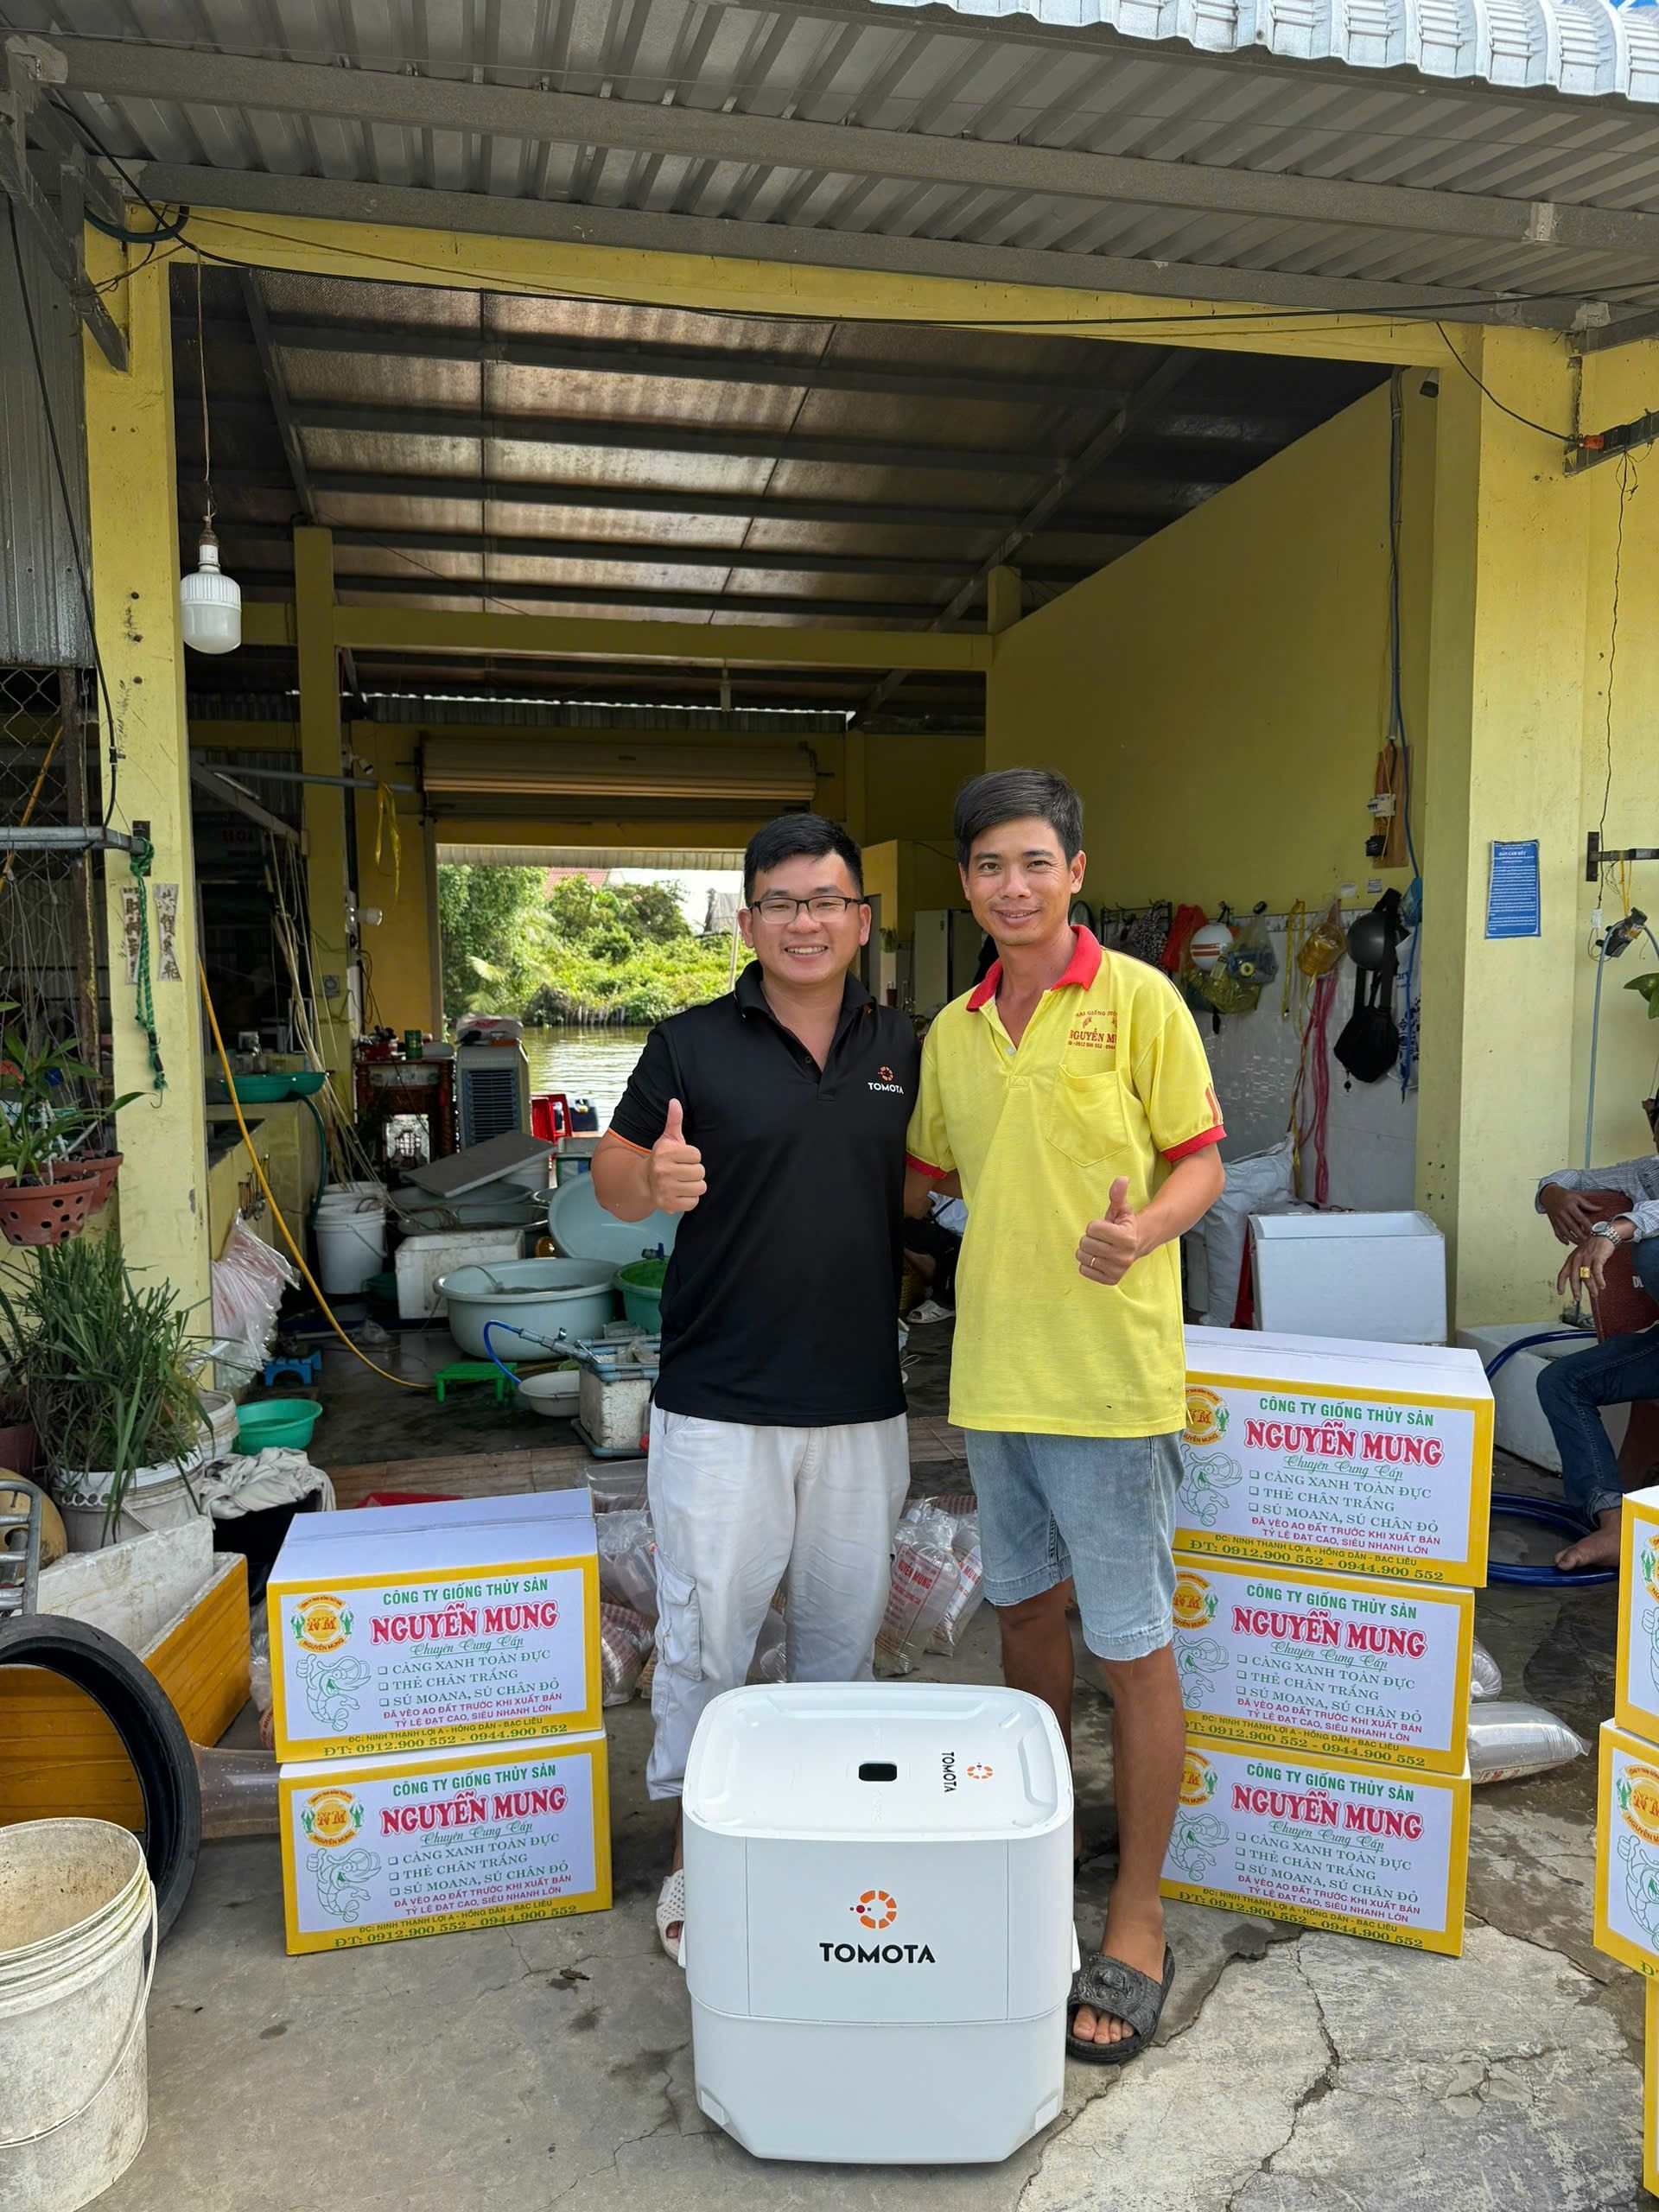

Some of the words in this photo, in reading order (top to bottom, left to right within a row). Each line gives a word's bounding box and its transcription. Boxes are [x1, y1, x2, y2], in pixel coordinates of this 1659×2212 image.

[868, 1082, 905, 1095] TOMOTA
[1259, 1395, 1295, 1413] CÔNG
[1300, 1402, 1316, 1414] TY
[1320, 1402, 1362, 1419] GIỐNG
[1366, 1406, 1402, 1423] THỦY
[1407, 1409, 1433, 1426] SẢN
[1244, 1417, 1357, 1459] NGUYỄN
[1360, 1430, 1442, 1466] MUNG
[1264, 1470, 1305, 1484] CÀNG
[1307, 1476, 1348, 1490] XANH
[1353, 1478, 1395, 1495] TOÀN
[1398, 1486, 1431, 1500] ĐỰC
[1189, 1539, 1217, 1552] ĐT:
[1222, 1543, 1290, 1561] 0912.900
[1295, 1554, 1324, 1566] 552
[1338, 1559, 1409, 1576] 0944.900
[1414, 1568, 1443, 1580] 552
[383, 1589, 418, 1605] CÔNG
[423, 1589, 438, 1601] TY
[442, 1582, 481, 1599] GIỐNG
[486, 1579, 518, 1596] THỦY
[523, 1576, 547, 1592] SẢN
[1246, 1583, 1281, 1600] CÔNG
[1286, 1590, 1302, 1603] TY
[1306, 1591, 1346, 1610] GIỐNG
[1351, 1598, 1386, 1614] THỦY
[1390, 1602, 1416, 1618] SẢN
[369, 1602, 477, 1644] NGUYỄN
[484, 1601, 558, 1634] MUNG
[1232, 1605, 1342, 1647] NGUYỄN
[1345, 1621, 1425, 1659] MUNG
[392, 1661, 431, 1674] CÀNG
[435, 1657, 474, 1670] XANH
[478, 1649, 518, 1666] TOÀN
[520, 1649, 550, 1662] ĐỰC
[392, 1675, 422, 1689] THẺ
[425, 1673, 466, 1687] CHÂN
[469, 1667, 518, 1682] TRẮNG
[1251, 1655, 1291, 1670] CÀNG
[1294, 1662, 1334, 1677] XANH
[1338, 1665, 1379, 1684] TOÀN
[1382, 1676, 1414, 1689] ĐỰC
[393, 1693, 411, 1706] SÚ
[416, 1690, 471, 1704] MOANA,
[474, 1685, 492, 1698] SÚ
[496, 1681, 535, 1695] CHÂN
[538, 1676, 559, 1690] ĐỎ
[1250, 1671, 1280, 1684] THẺ
[1283, 1677, 1325, 1692] CHÂN
[1327, 1683, 1378, 1700] TRẮNG
[322, 1745, 352, 1756] ĐT:
[356, 1738, 423, 1752] 0912.900
[429, 1735, 455, 1745] 552
[468, 1727, 536, 1740] 0944.900
[539, 1725, 566, 1733] 552
[392, 1780, 428, 1796] CÔNG
[431, 1778, 447, 1791] TY
[451, 1770, 491, 1789] GIỐNG
[494, 1765, 527, 1783] THỦY
[531, 1762, 556, 1778] SẢN
[941, 1751, 957, 1793] TOMOTA
[1247, 1762, 1281, 1780] CÔNG
[1285, 1770, 1300, 1783] TY
[1305, 1772, 1344, 1790] GIỐNG
[1349, 1779, 1383, 1796] THỦY
[1388, 1784, 1414, 1802] SẢN
[382, 1789, 487, 1834] NGUYỄN
[493, 1787, 566, 1819] MUNG
[1231, 1782, 1338, 1826] NGUYỄN
[1344, 1802, 1422, 1840] MUNG
[403, 1850, 442, 1864] CÀNG
[445, 1844, 484, 1858] XANH
[487, 1834, 527, 1852] TOÀN
[530, 1833, 559, 1846] ĐỰC
[1249, 1834, 1288, 1849] CÀNG
[1292, 1841, 1332, 1857] XANH
[1336, 1846, 1377, 1865] TOÀN
[1379, 1857, 1411, 1871] ĐỰC
[334, 1936, 363, 1947] ĐT:
[367, 1925, 435, 1942] 0912.900
[439, 1921, 467, 1931] 552
[480, 1910, 545, 1925] 0944.900
[550, 1904, 575, 1916] 552
[1179, 1892, 1206, 1905] ĐT:
[1211, 1898, 1275, 1919] 0912.900
[1280, 1912, 1307, 1925] 552
[1320, 1921, 1389, 1942] 0944.900
[1394, 1935, 1422, 1948] 552
[818, 1942, 937, 1964] TOMOTA
